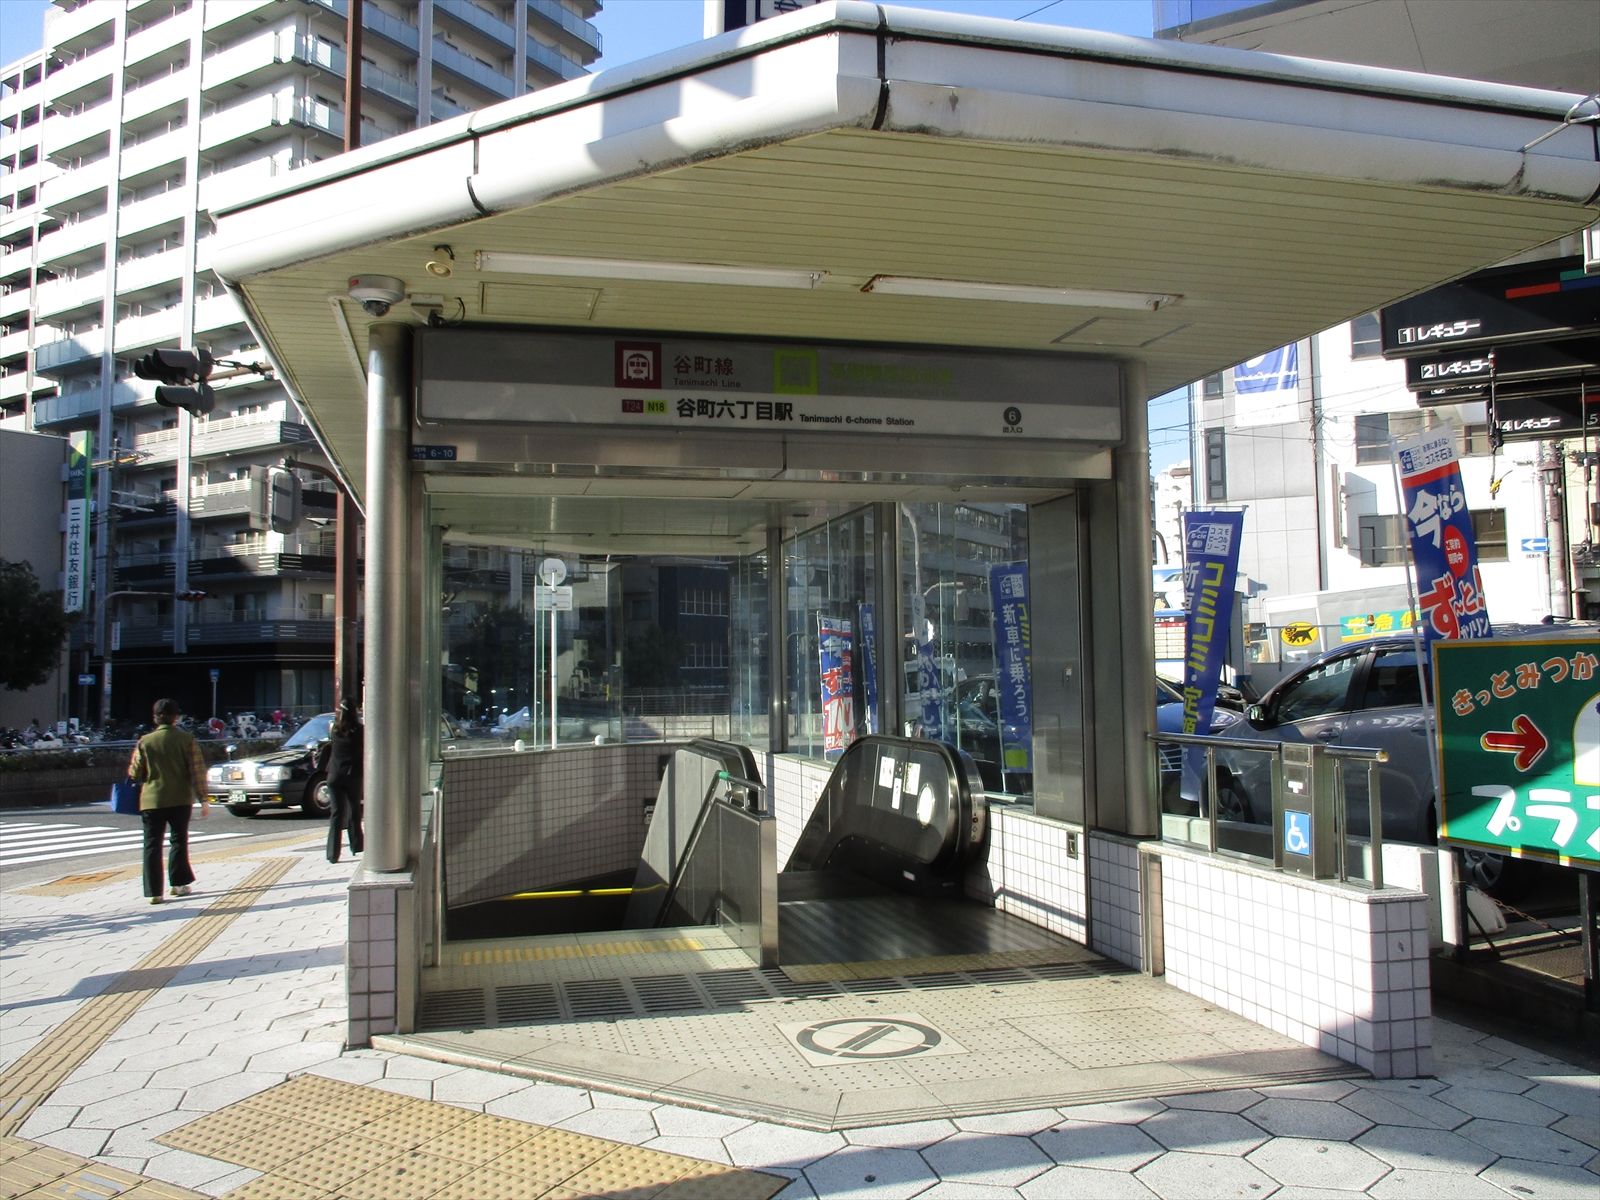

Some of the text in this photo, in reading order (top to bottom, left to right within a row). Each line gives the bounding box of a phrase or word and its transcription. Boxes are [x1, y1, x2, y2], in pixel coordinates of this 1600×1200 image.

[1401, 320, 1481, 343] 1 レギュラー
[673, 355, 735, 376] 谷町線
[1422, 359, 1490, 378] 2 レギュラー
[673, 377, 742, 389] Tanimachi Line
[648, 402, 665, 412] N18
[676, 398, 794, 422] 谷町六丁目駅
[799, 413, 915, 427] Tanimachi 6-chome Station
[1501, 417, 1560, 431] 4 レギュラー
[431, 449, 454, 458] 6-10
[1408, 484, 1465, 550] 今なら
[1210, 527, 1229, 535] コスモ
[1206, 543, 1226, 552] リース
[67, 507, 82, 606] 三井住友銀行
[1471, 784, 1600, 852] プラ
